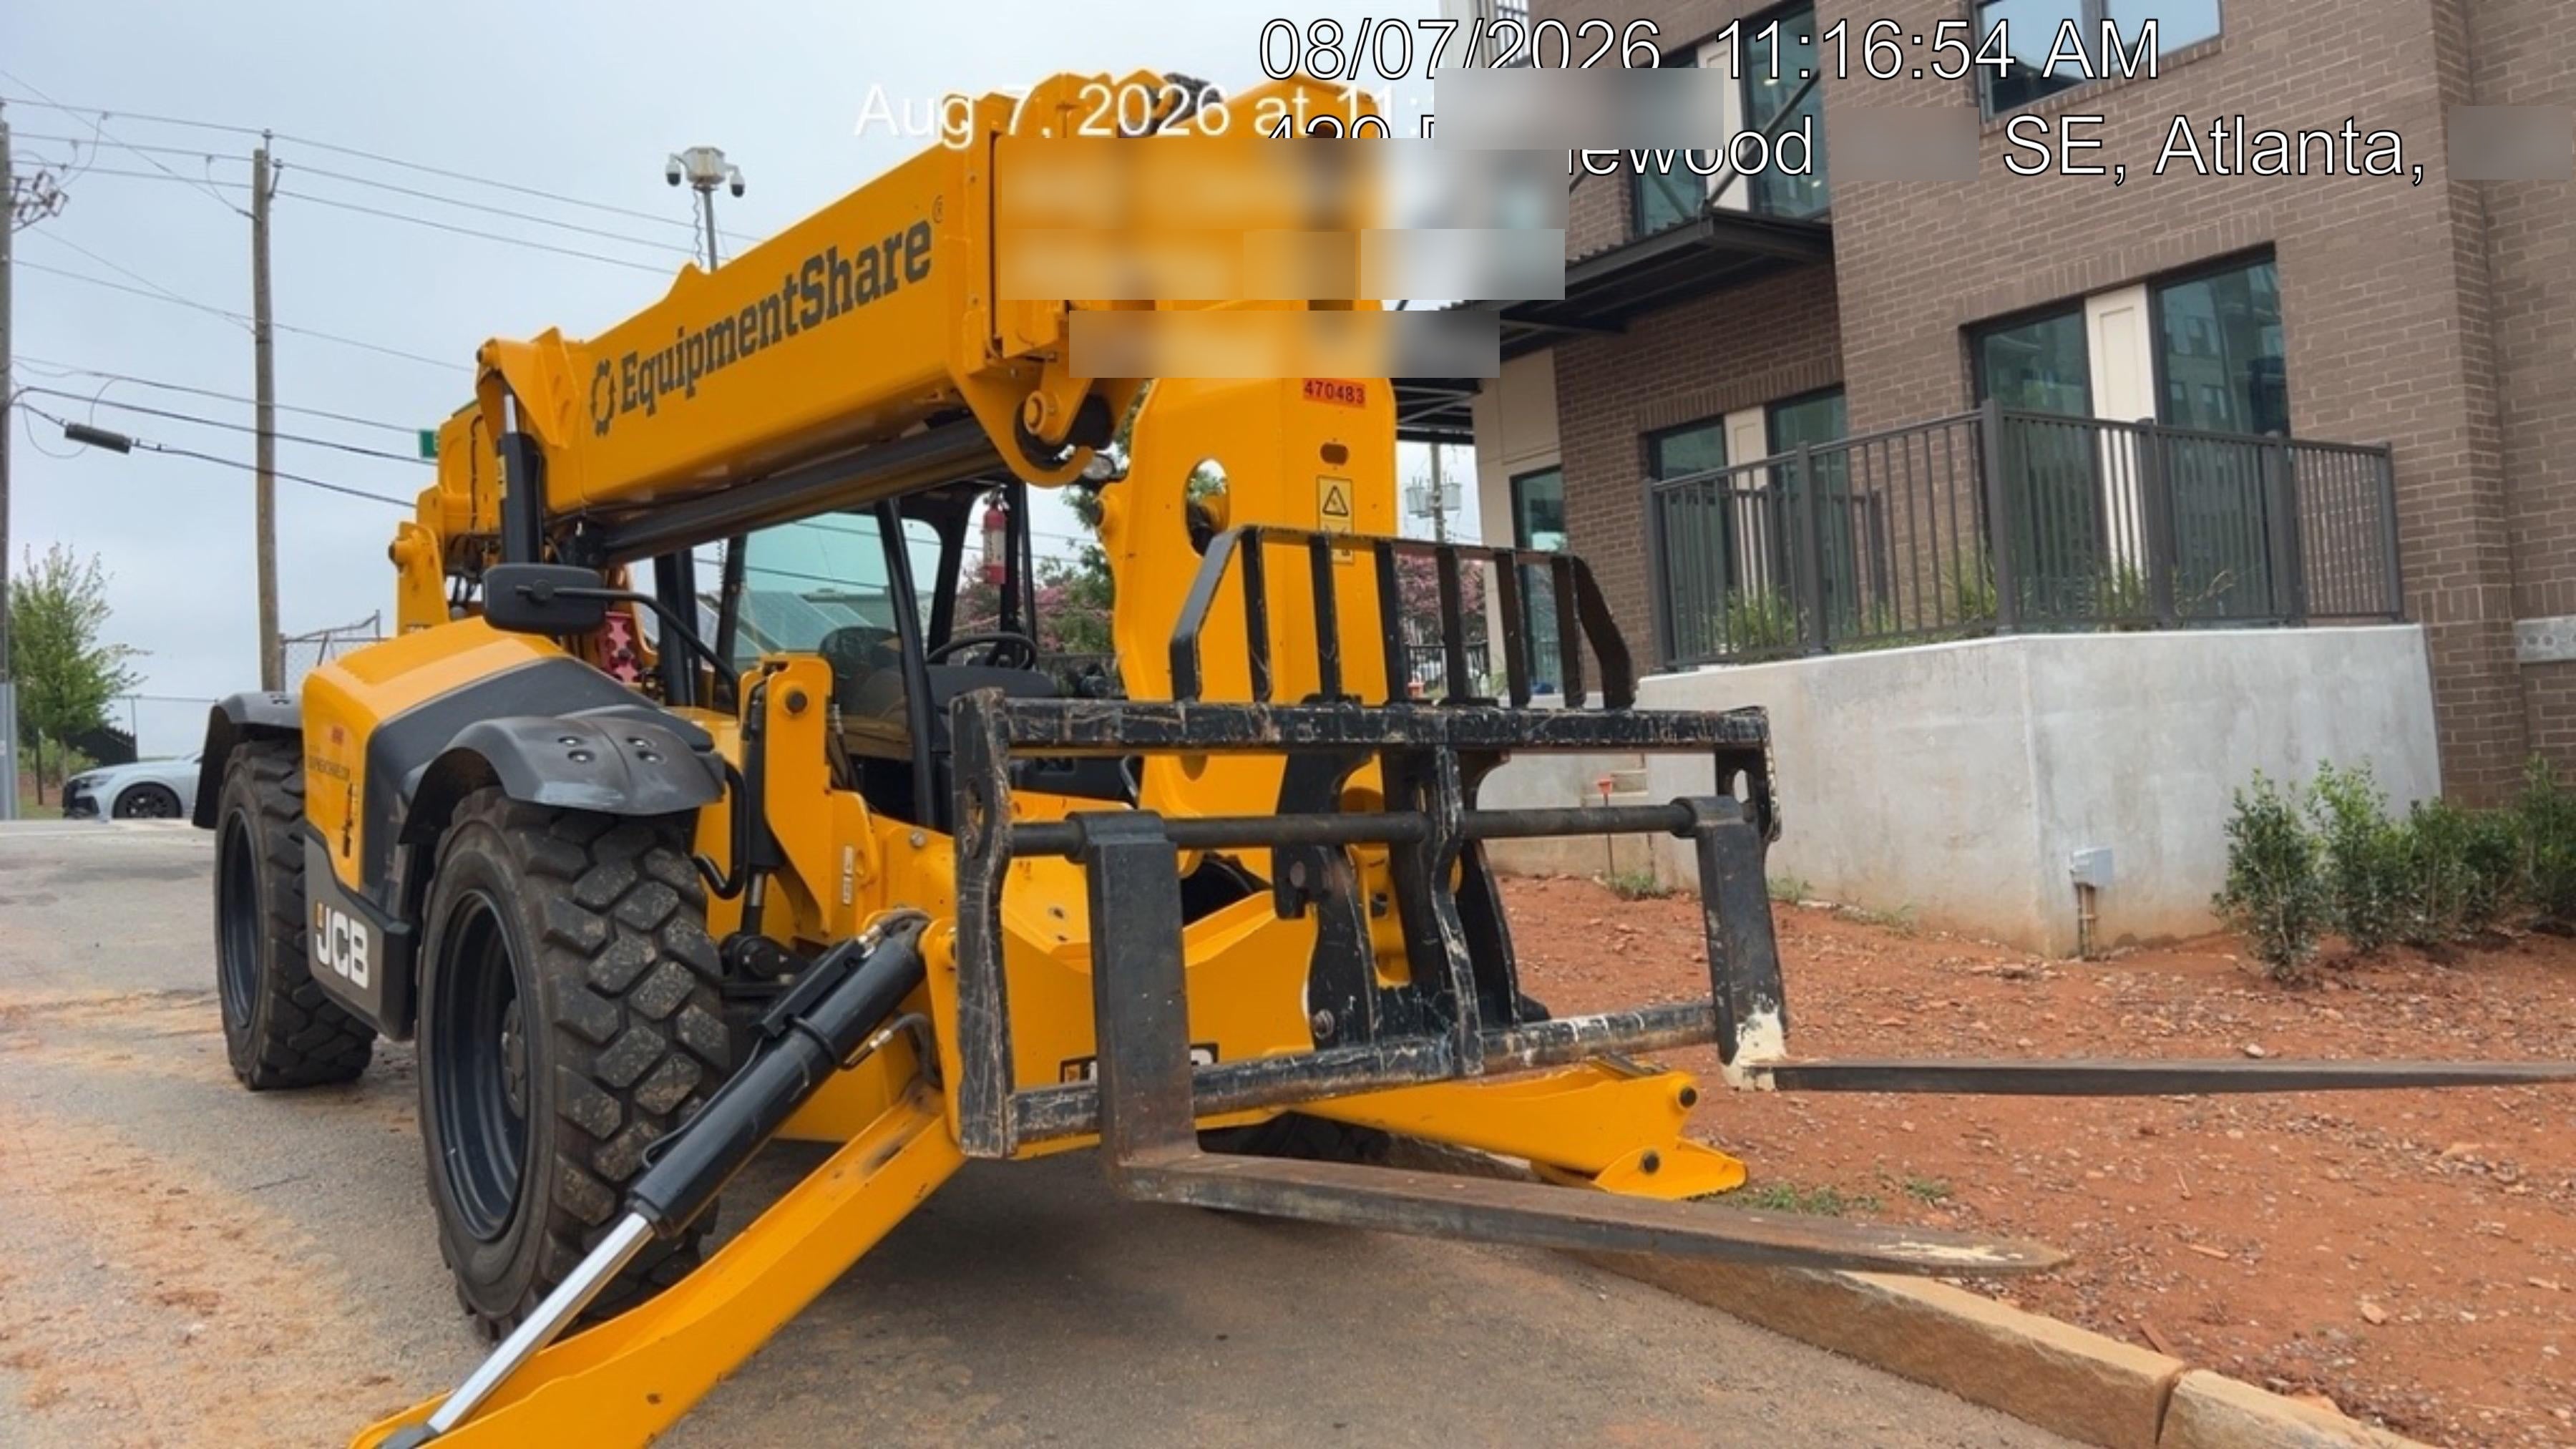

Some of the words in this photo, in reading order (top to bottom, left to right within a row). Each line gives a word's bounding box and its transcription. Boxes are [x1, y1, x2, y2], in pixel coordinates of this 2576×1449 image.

[620, 220, 932, 418] EquipmentShare
[1304, 379, 1365, 404] 470483
[315, 905, 369, 990] JCB
